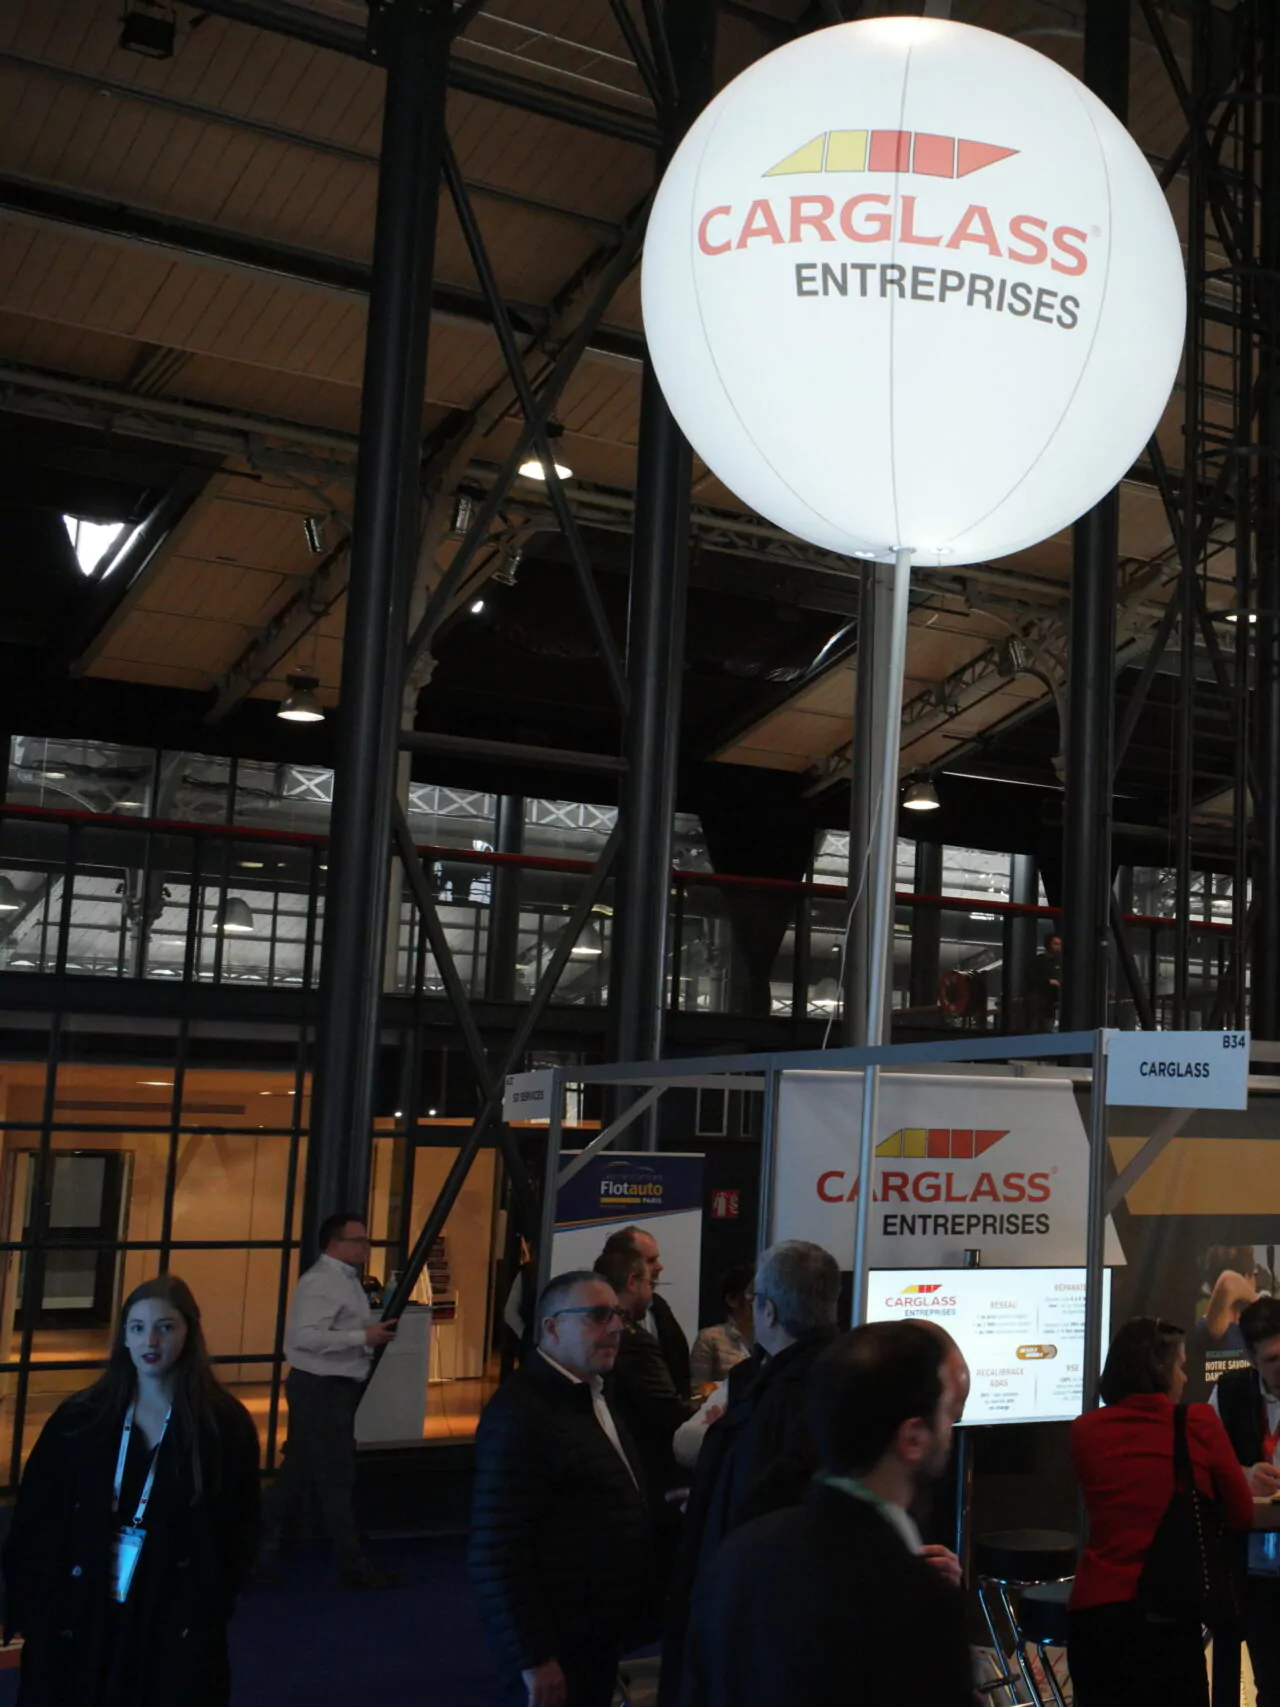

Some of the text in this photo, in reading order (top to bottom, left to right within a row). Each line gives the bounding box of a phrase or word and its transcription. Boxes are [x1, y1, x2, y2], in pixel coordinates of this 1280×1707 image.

[698, 193, 1090, 276] CARGLASS
[795, 262, 1081, 330] ENTREPRISES
[1222, 1034, 1247, 1049] B34
[1139, 1061, 1211, 1079] CARGLASS
[600, 1180, 664, 1196] Flotauto
[882, 1213, 1050, 1236] ENTREPRISES
[885, 1296, 957, 1307] CARGLASS
[904, 1309, 956, 1317] ENTREPRISES
[1205, 1360, 1226, 1371] NOTRE
